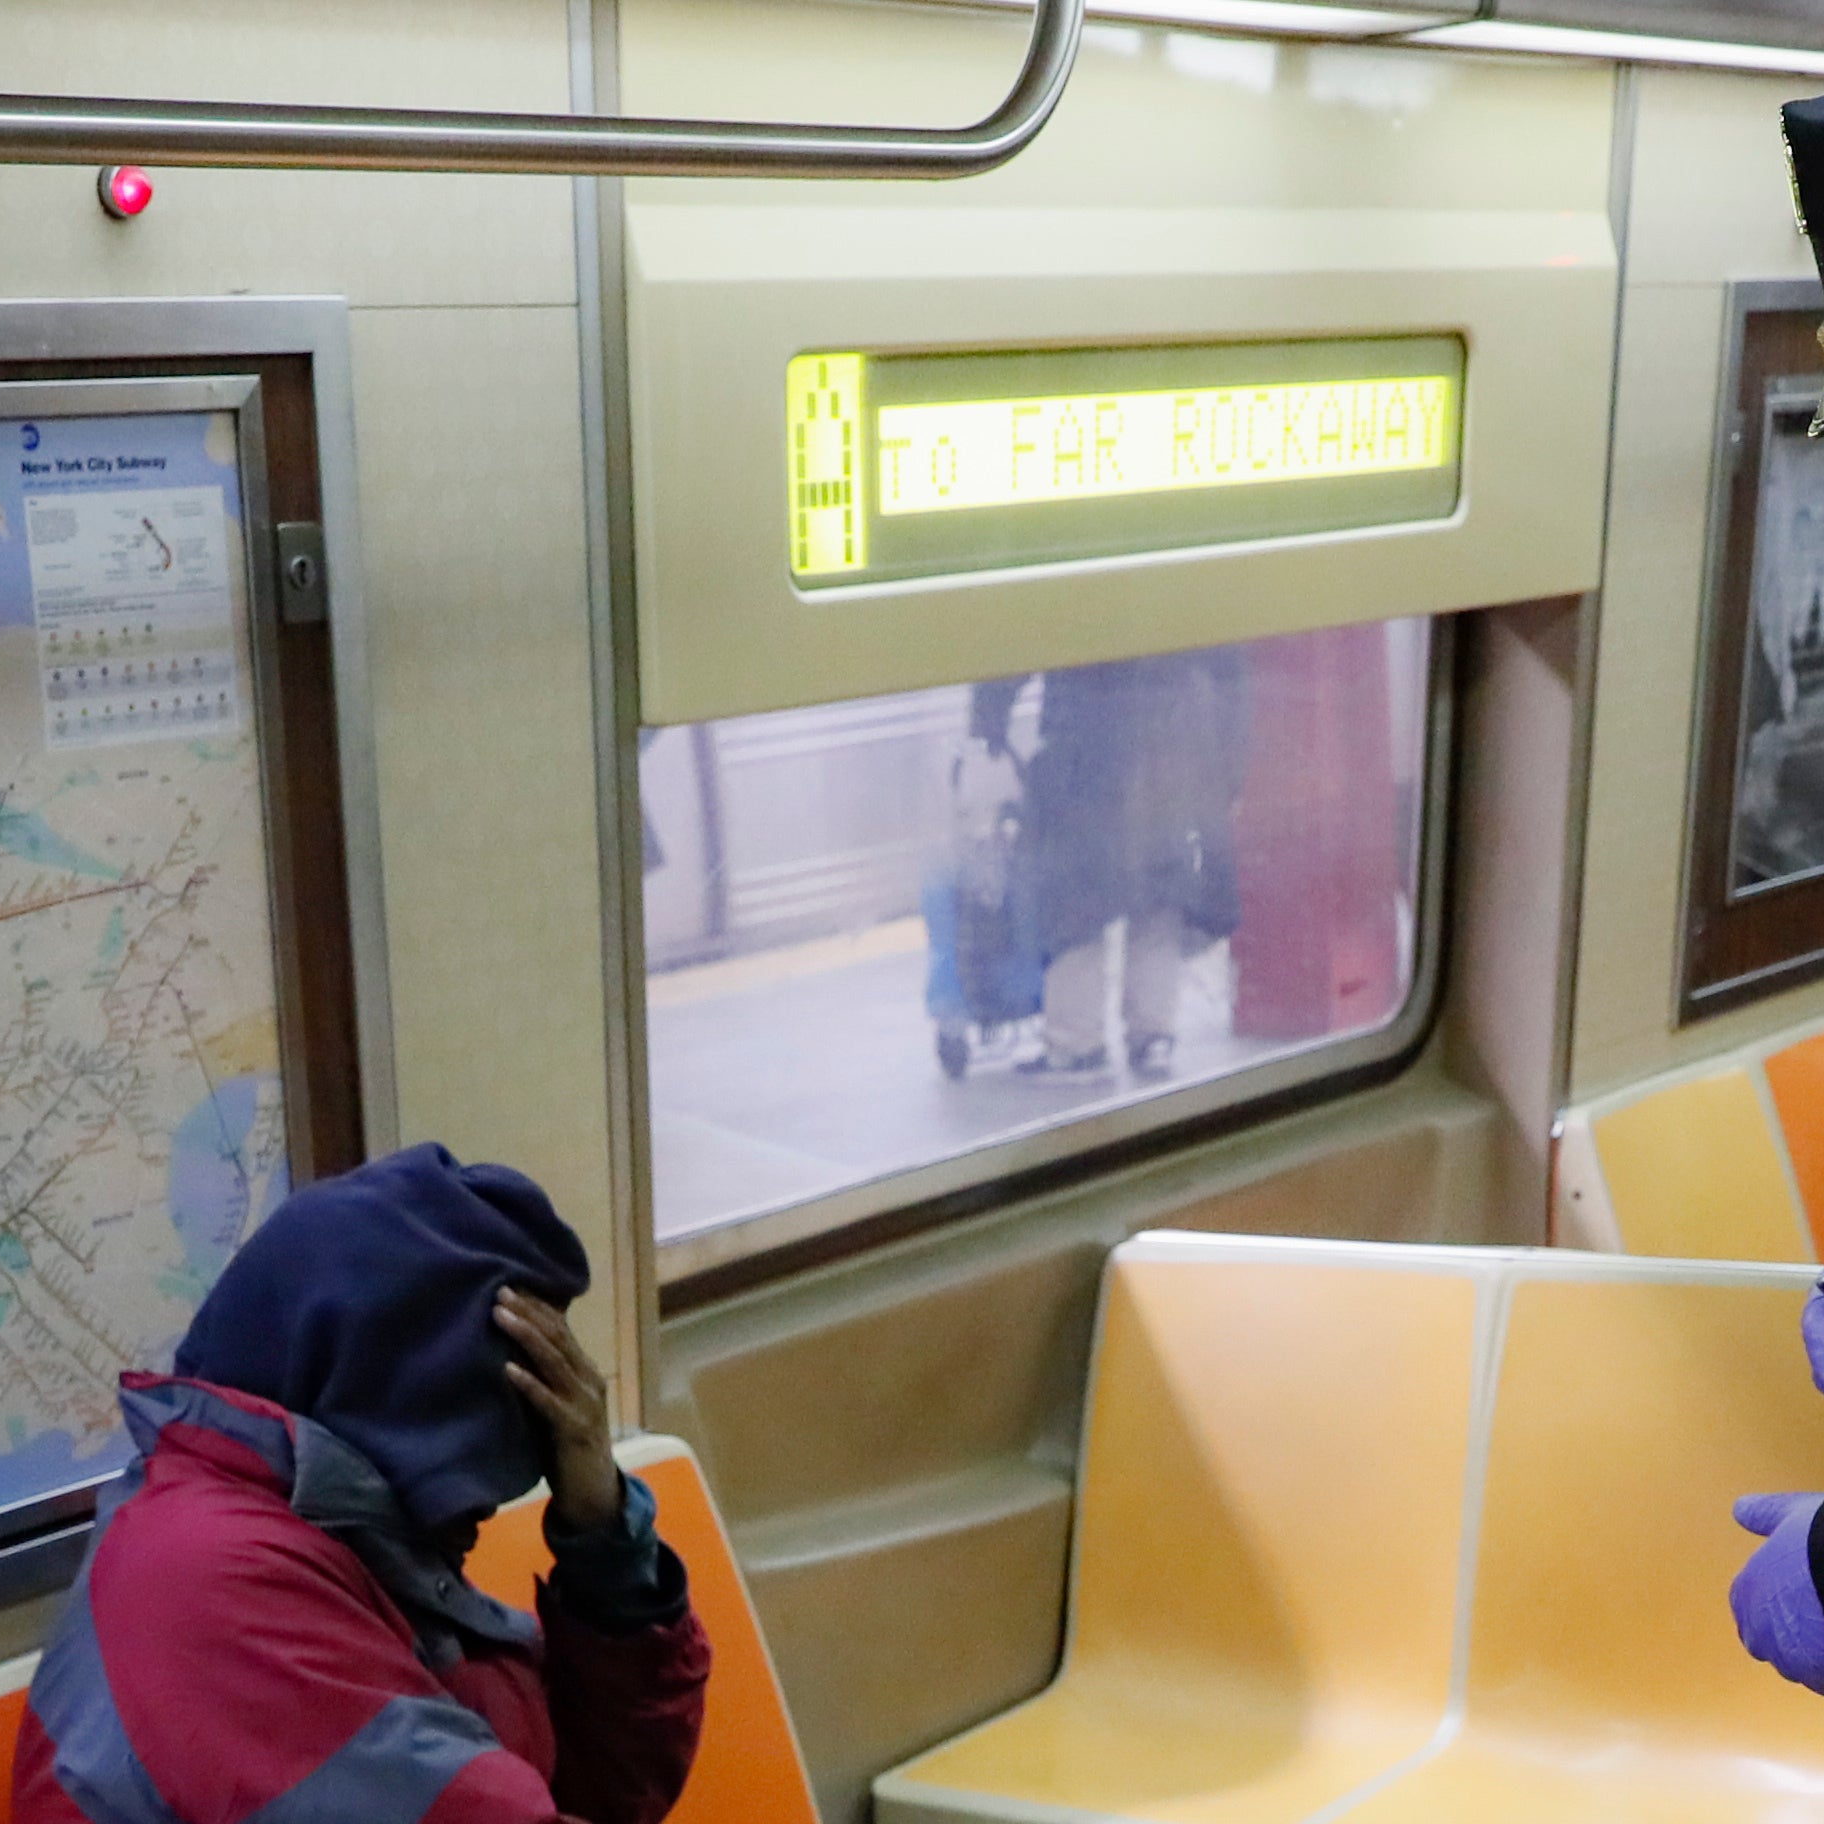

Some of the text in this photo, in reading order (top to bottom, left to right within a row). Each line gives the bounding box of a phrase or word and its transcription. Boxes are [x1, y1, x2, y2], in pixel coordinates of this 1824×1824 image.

[21, 455, 167, 474] New York City Subway
[1011, 402, 1124, 490] FAR
[1173, 382, 1442, 476] ROCKAWAY
